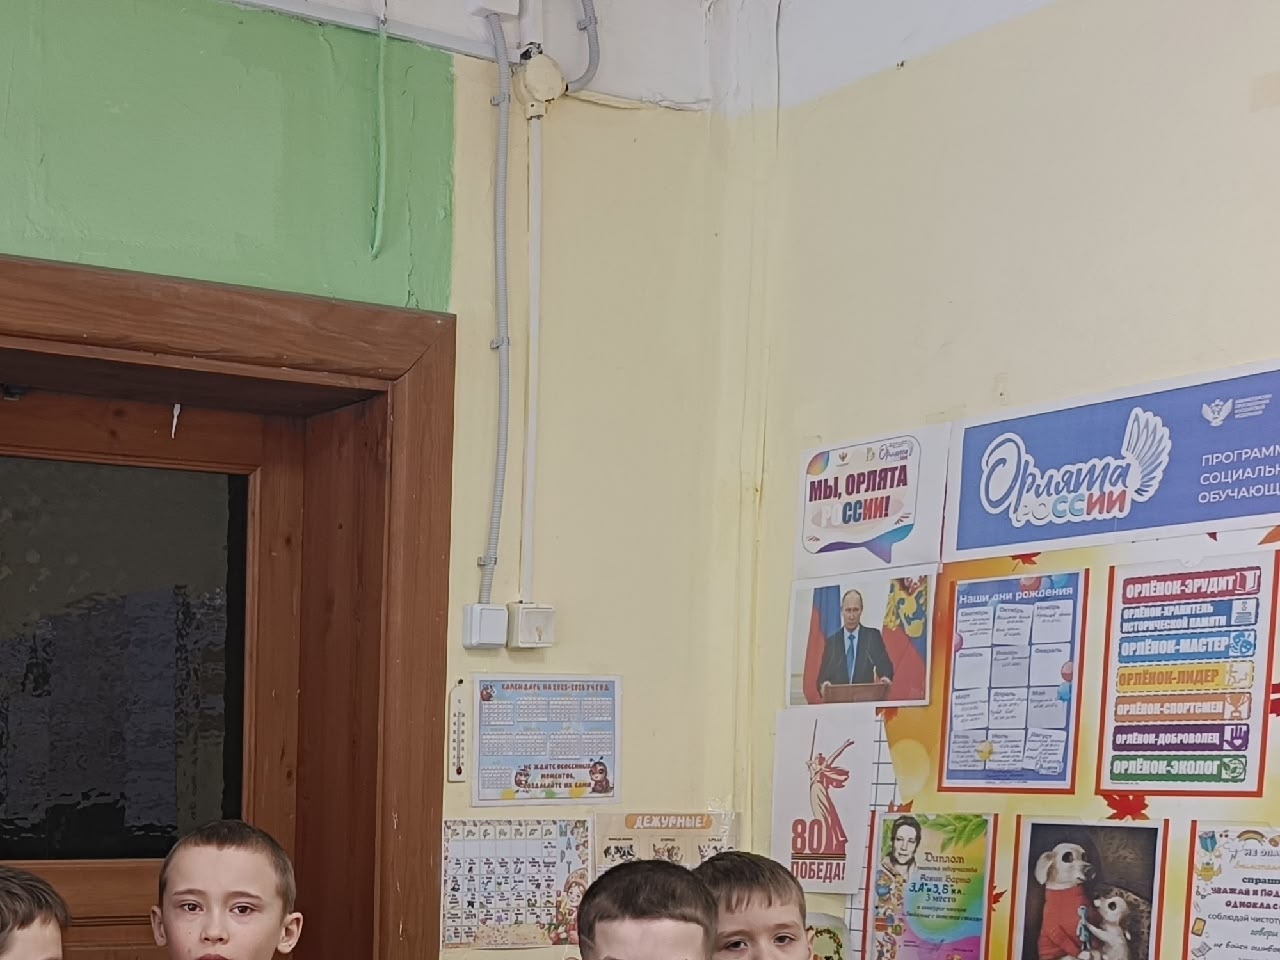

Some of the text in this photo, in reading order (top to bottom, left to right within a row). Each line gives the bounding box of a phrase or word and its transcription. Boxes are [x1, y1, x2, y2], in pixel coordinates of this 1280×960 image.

[809, 465, 908, 502] МЫ, ОРЛЯТА
[985, 437, 1131, 515] Орлята
[1198, 483, 1280, 503] ОБУЧАЮЩ
[959, 594, 989, 604] Наши
[1016, 587, 1073, 601] рождения
[1125, 576, 1236, 599] ОРЛЁНОК-ЭРУДИТ
[1121, 637, 1230, 656] ОРЛЁНОК-МАСТЕР
[1119, 669, 1220, 687] ОРЛЁНОК-ЛИДЕР
[1116, 700, 1224, 716] ОРЛЁНОК-СПОРТСМЕН
[1115, 732, 1220, 746] ОРЛЁНОК-ДОБРОВОЛЕЦ
[1113, 757, 1220, 775] ОРЛЁНОК-ЭКОЛОГ
[792, 818, 823, 854] 80
[791, 861, 846, 883] ПОБЕДА!
[1225, 900, 1280, 910] ОДНОКЛАС
